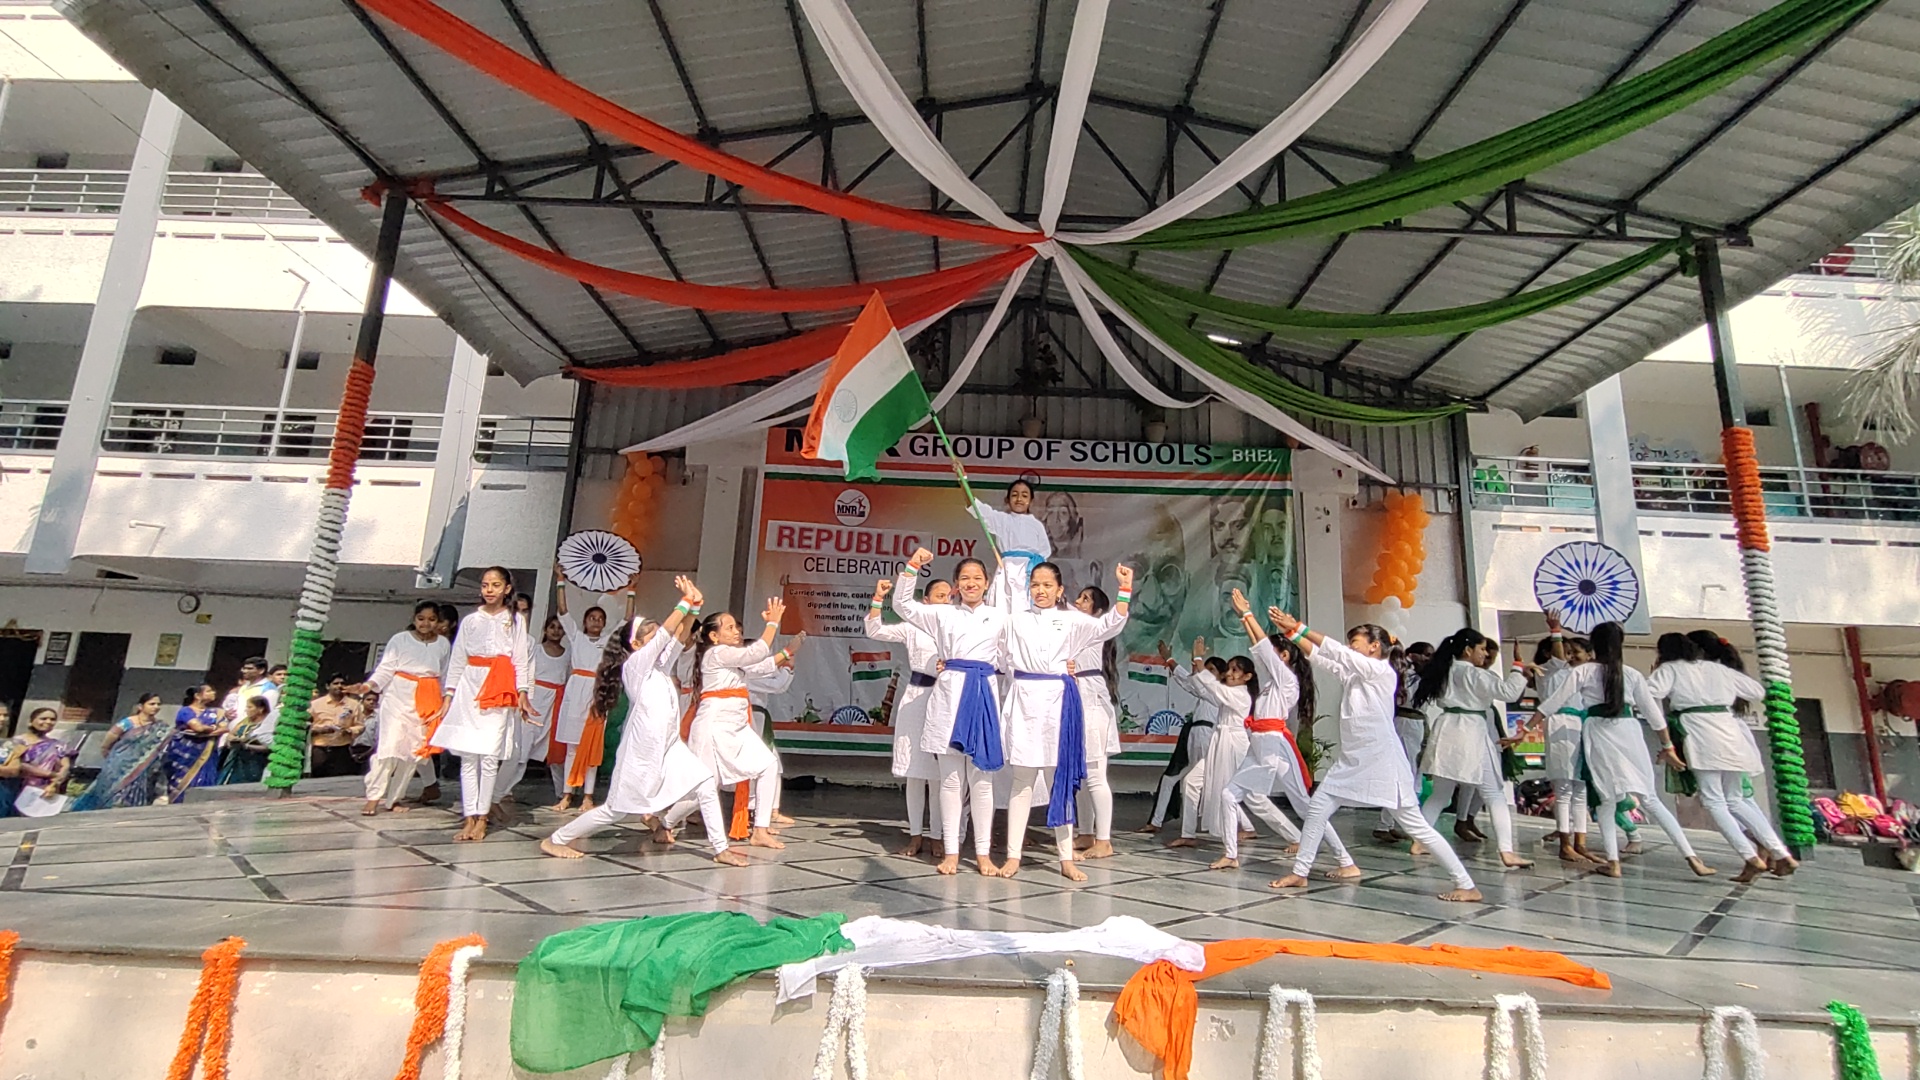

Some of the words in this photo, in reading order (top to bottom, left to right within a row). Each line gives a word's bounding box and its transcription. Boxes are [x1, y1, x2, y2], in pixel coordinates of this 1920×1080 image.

[909, 435, 1015, 459] GROUP
[1023, 439, 1061, 461] OF
[1232, 449, 1278, 463] BHEL
[836, 504, 858, 516] MNR
[777, 525, 920, 557] REPUBLIC
[937, 538, 978, 556] DAY
[803, 557, 931, 577] CELEBRATIOS
[789, 589, 815, 597] Carried
[832, 591, 850, 599] care,
[807, 602, 831, 610] dipped
[841, 602, 857, 610] love,
[858, 603, 867, 611] fly
